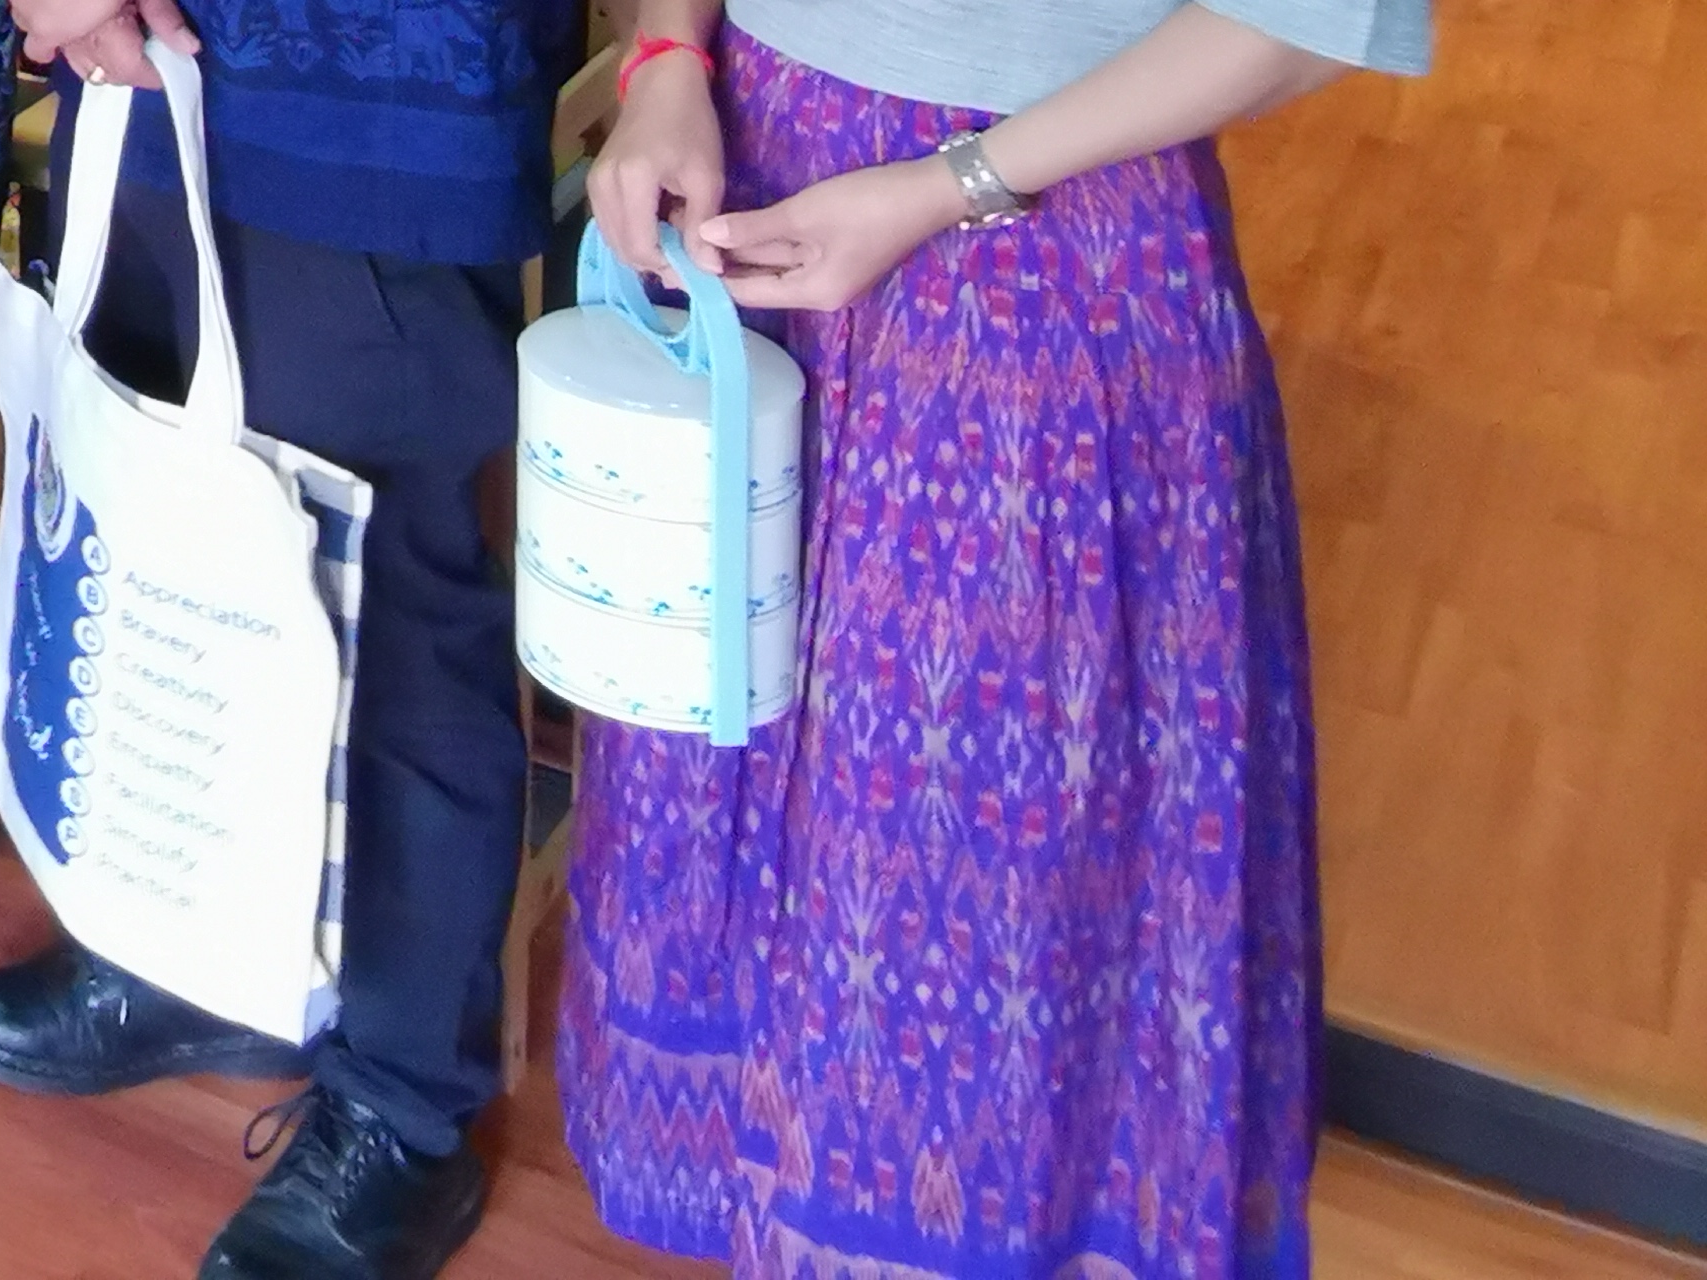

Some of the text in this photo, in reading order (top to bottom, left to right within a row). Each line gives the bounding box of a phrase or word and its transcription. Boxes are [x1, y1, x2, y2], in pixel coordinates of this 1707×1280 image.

[120, 608, 207, 664] Bravery
[121, 571, 281, 640] Appreciation
[115, 652, 229, 714] Creativity
[113, 690, 226, 756] Discovery
